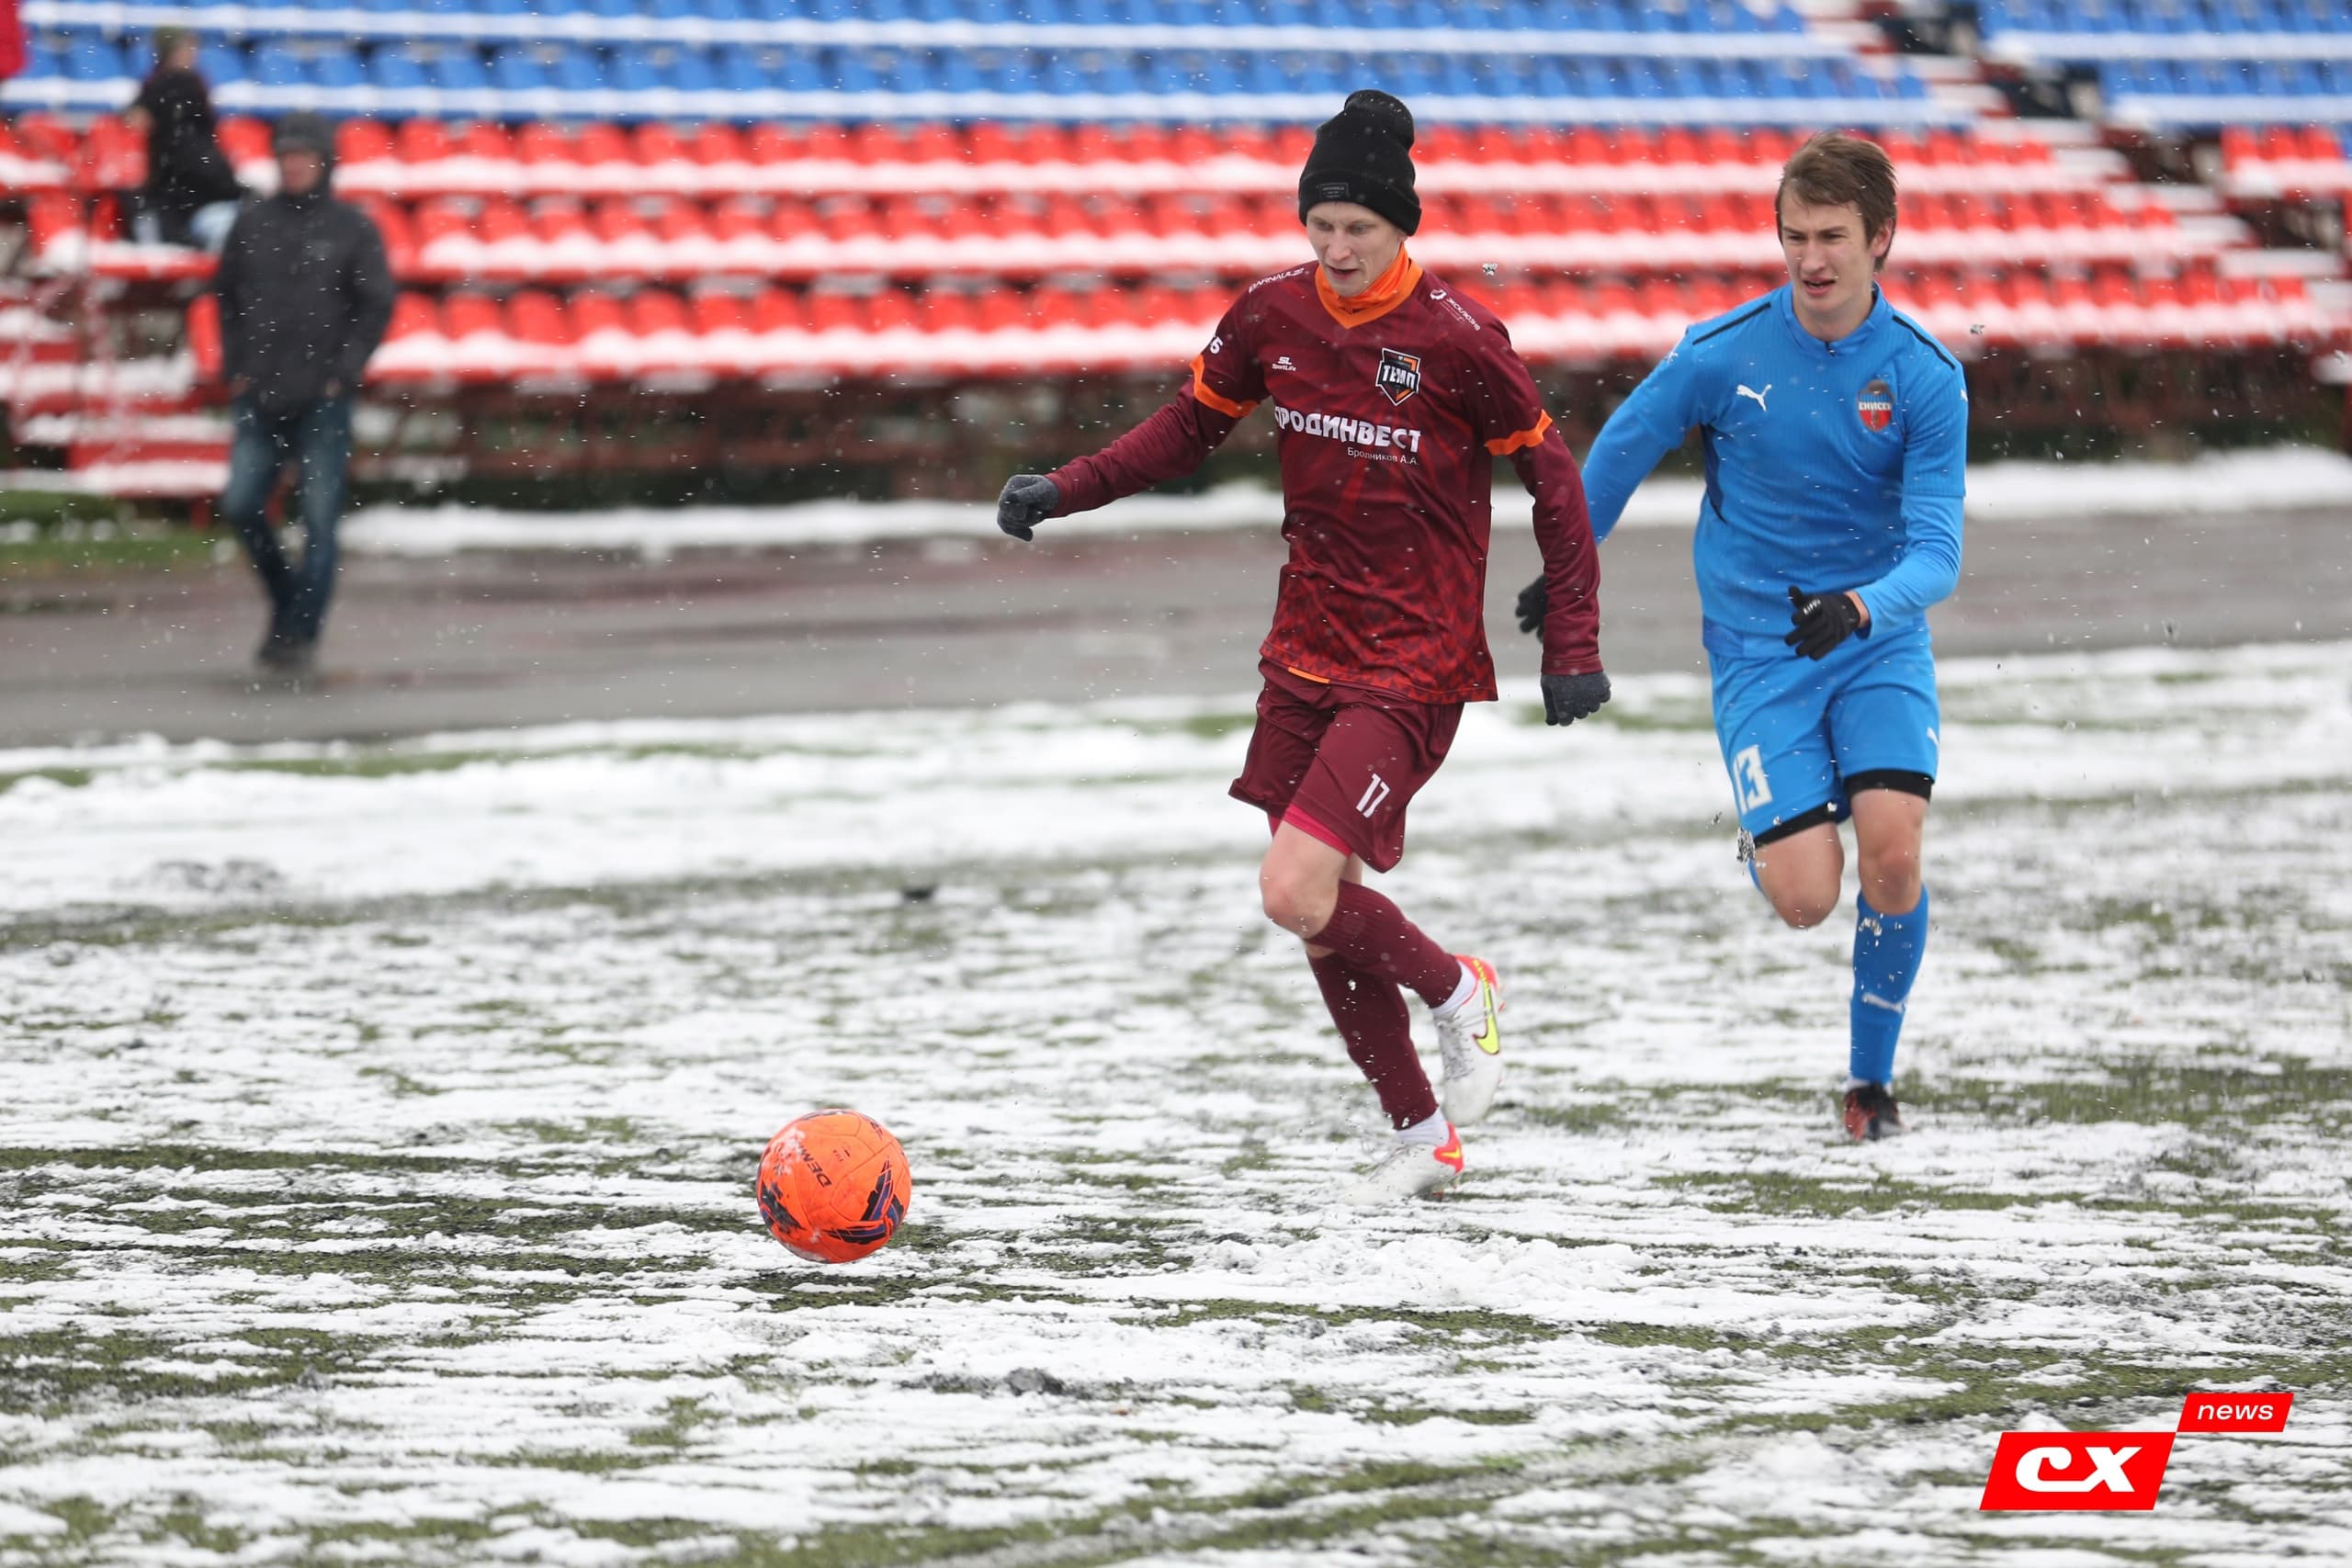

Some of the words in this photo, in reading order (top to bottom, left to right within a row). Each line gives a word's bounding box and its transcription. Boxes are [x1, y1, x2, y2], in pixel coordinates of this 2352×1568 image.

[1382, 365, 1416, 389] ТЕМП
[1347, 446, 1398, 463] Бродников
[1355, 773, 1390, 818] 17
[1733, 744, 1773, 816] 13
